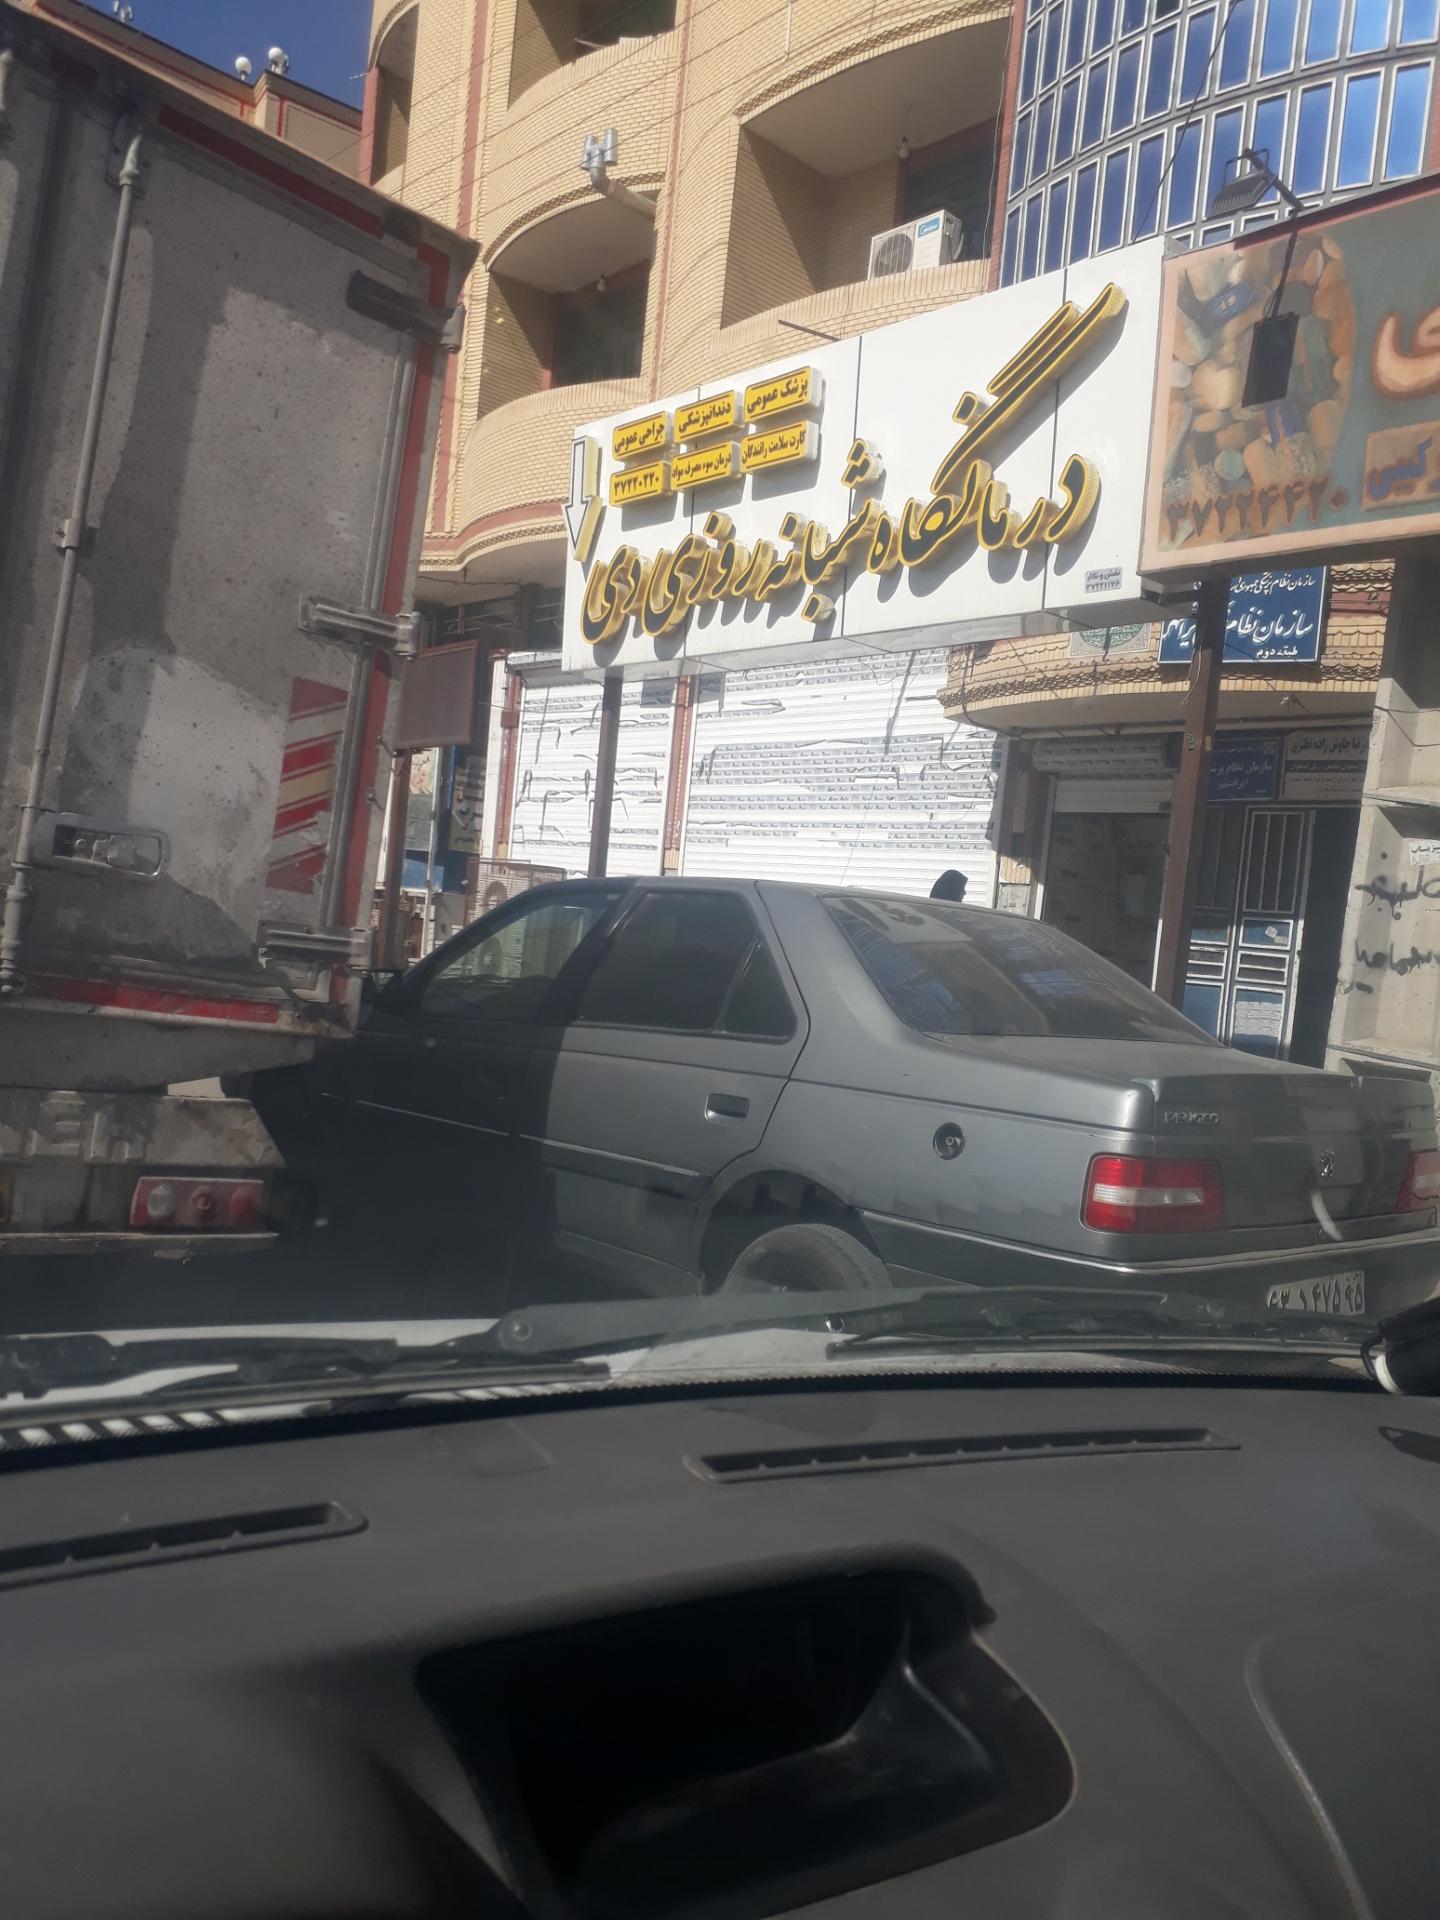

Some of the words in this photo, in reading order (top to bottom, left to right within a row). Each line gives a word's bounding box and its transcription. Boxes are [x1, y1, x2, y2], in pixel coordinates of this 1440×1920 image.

[780, 377, 808, 400] پزشک
[747, 388, 778, 413] عمومی
[678, 401, 732, 433] دندانپزشکی
[866, 281, 1127, 575] درمانگاه
[614, 431, 638, 453] عمومی
[638, 421, 665, 446] جراحی
[769, 433, 789, 455] سلامت
[789, 429, 806, 450] کارت
[713, 452, 731, 471] درمان
[742, 441, 768, 464] رانندگان
[672, 465, 684, 481] مواد
[685, 461, 702, 477] مصرف
[1167, 473, 1349, 542] ۳۷۲۲۴۴۲۰
[641, 509, 757, 638] روزی
[1253, 571, 1273, 595] پزشکی
[1269, 573, 1289, 596] نظام
[1288, 573, 1316, 592] سازمان
[579, 544, 650, 648] دی
[1226, 606, 1258, 634] نظام
[1253, 608, 1313, 643] سازمان
[1256, 646, 1276, 659] دوم
[1276, 645, 1298, 657] طبقه
[1226, 760, 1244, 776] نظام
[1245, 759, 1273, 775] سازمان
